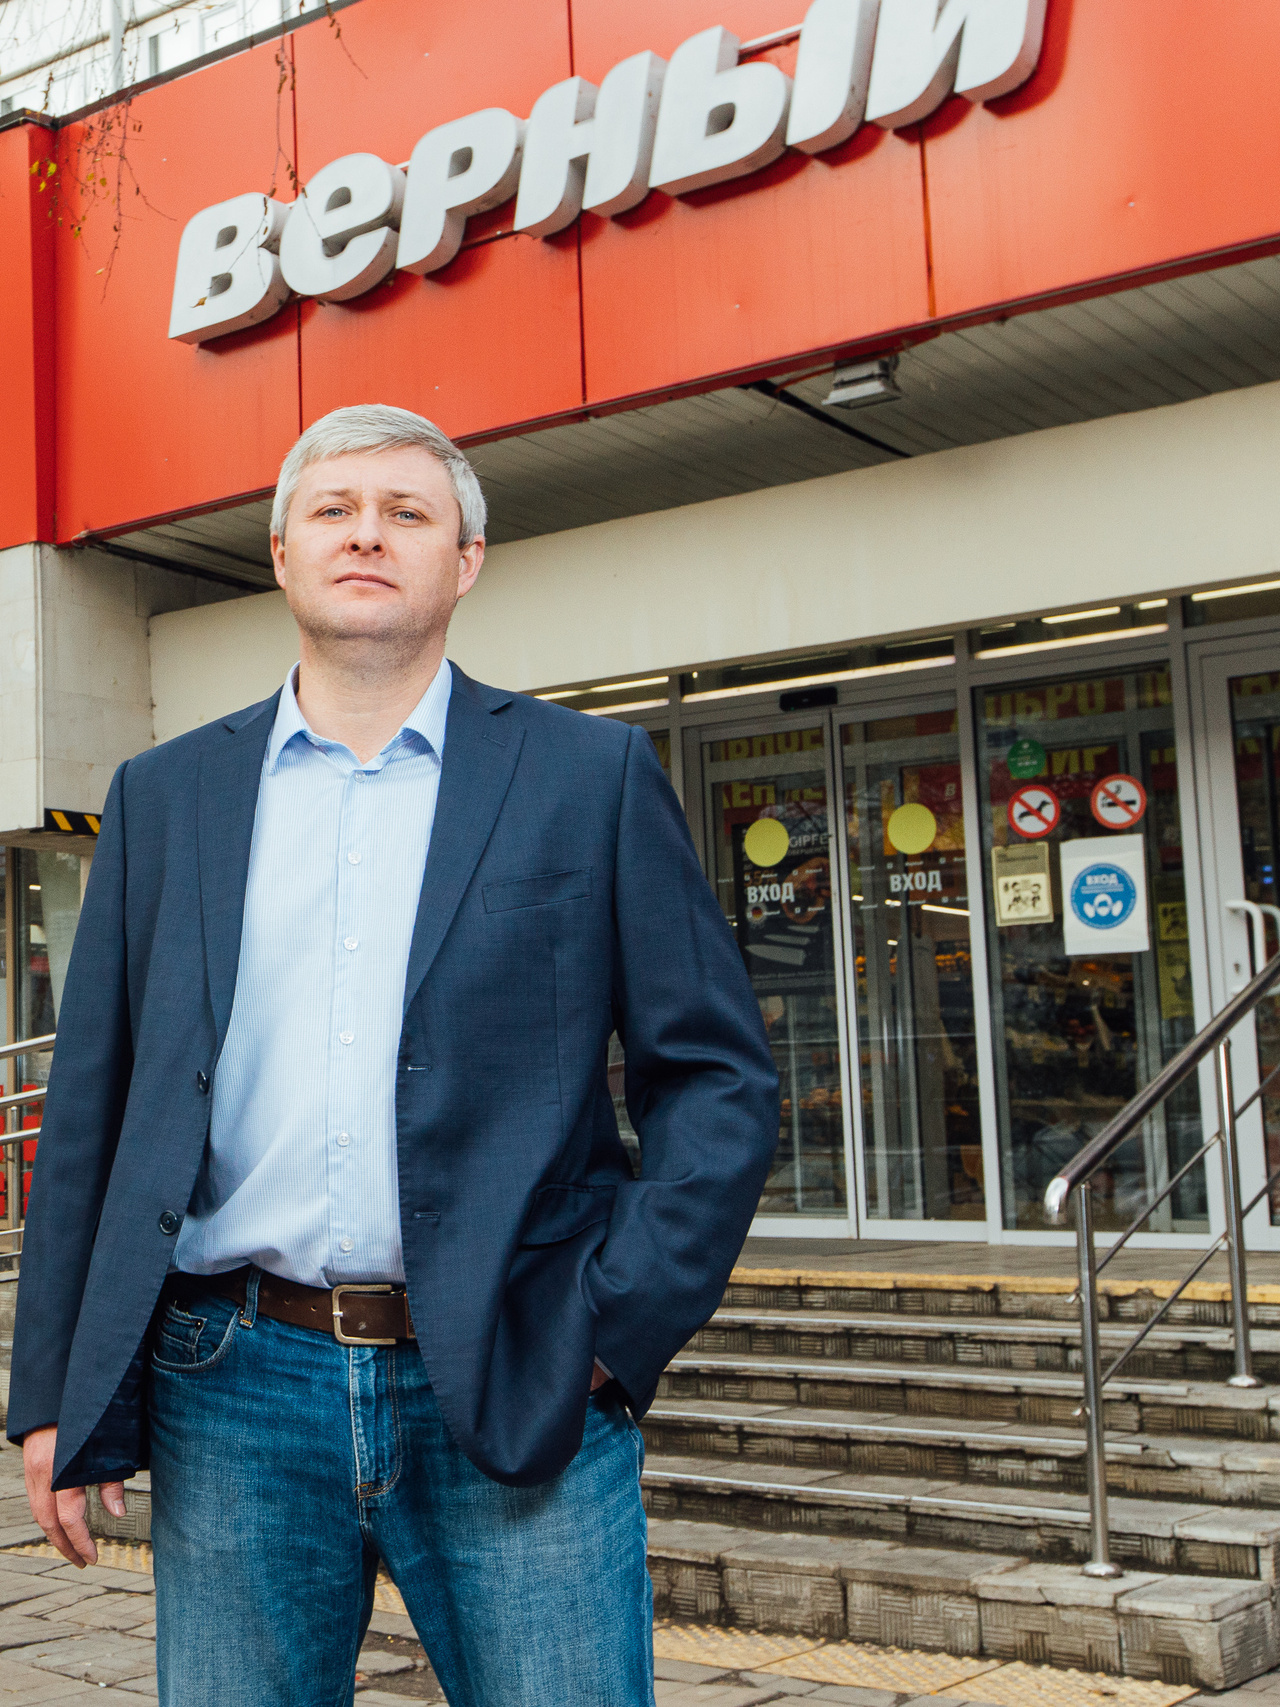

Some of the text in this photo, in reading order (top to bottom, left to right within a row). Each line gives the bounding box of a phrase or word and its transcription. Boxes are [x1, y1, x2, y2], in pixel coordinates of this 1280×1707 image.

[168, 0, 1047, 344] Верный
[889, 870, 943, 892] ВХОД
[1086, 873, 1119, 886] ВХОД
[747, 882, 795, 904] ВХОД
